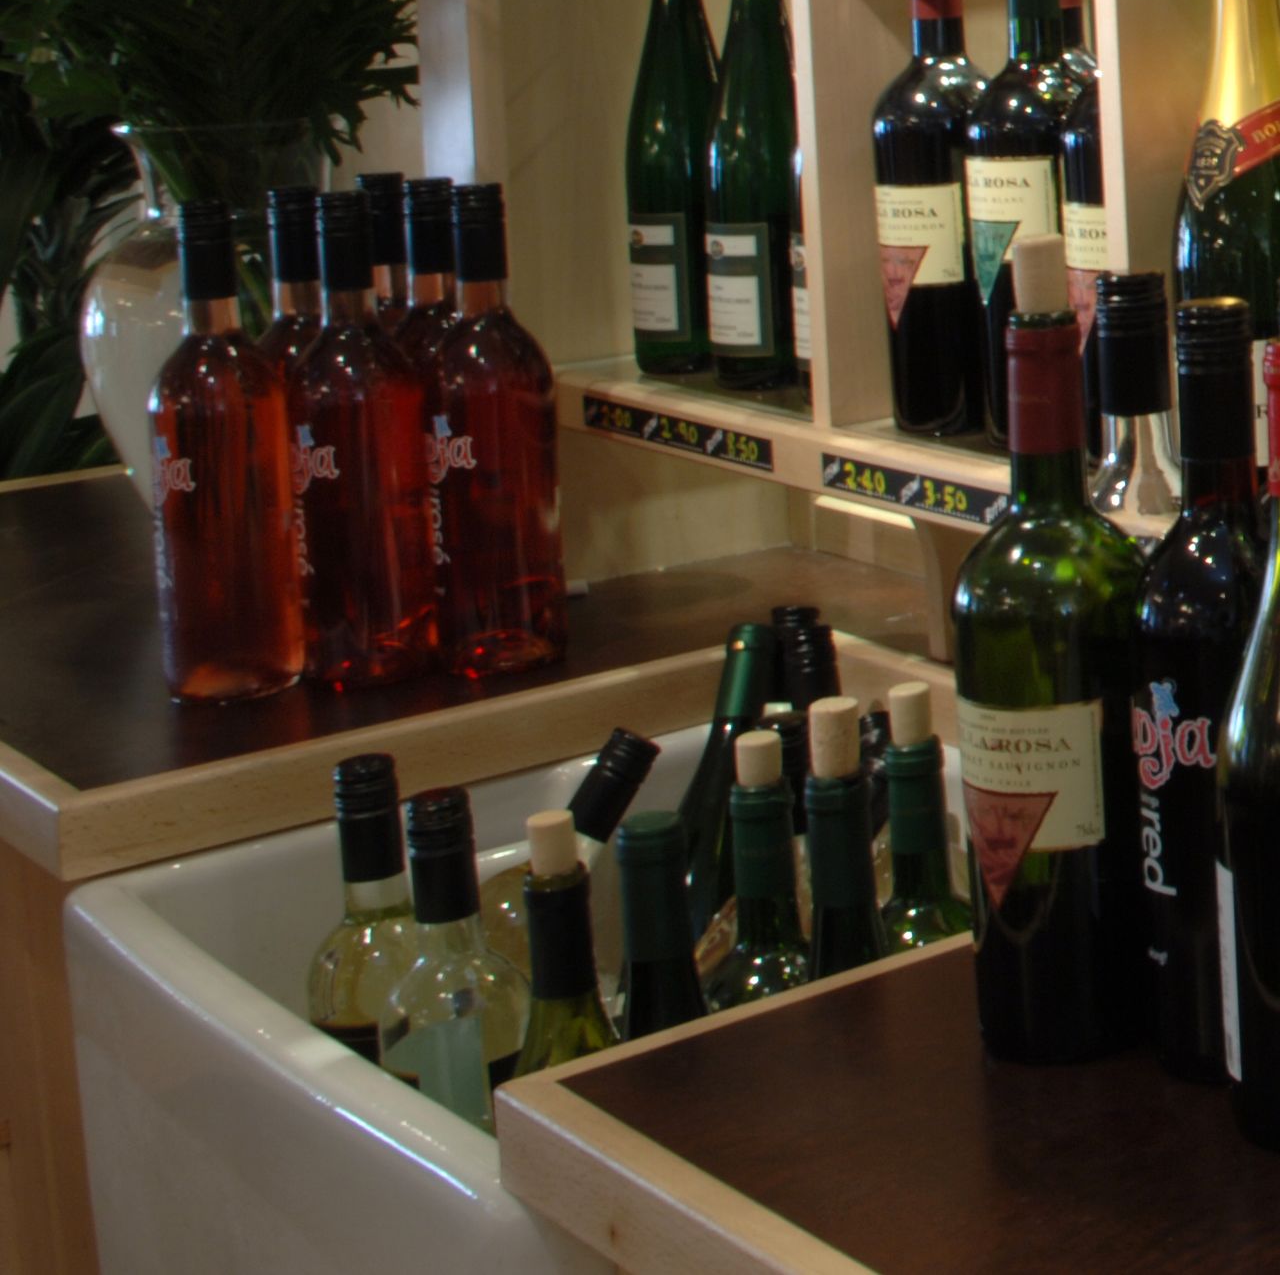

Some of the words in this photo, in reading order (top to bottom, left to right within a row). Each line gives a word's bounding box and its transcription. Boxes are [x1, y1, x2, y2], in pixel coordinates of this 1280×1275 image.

[983, 176, 1031, 189] ROSA
[891, 207, 939, 220] ROSA
[843, 461, 886, 494] 2.40
[923, 478, 968, 512] 3.50
[996, 735, 1072, 755] ROSA
[1140, 806, 1178, 897] red
